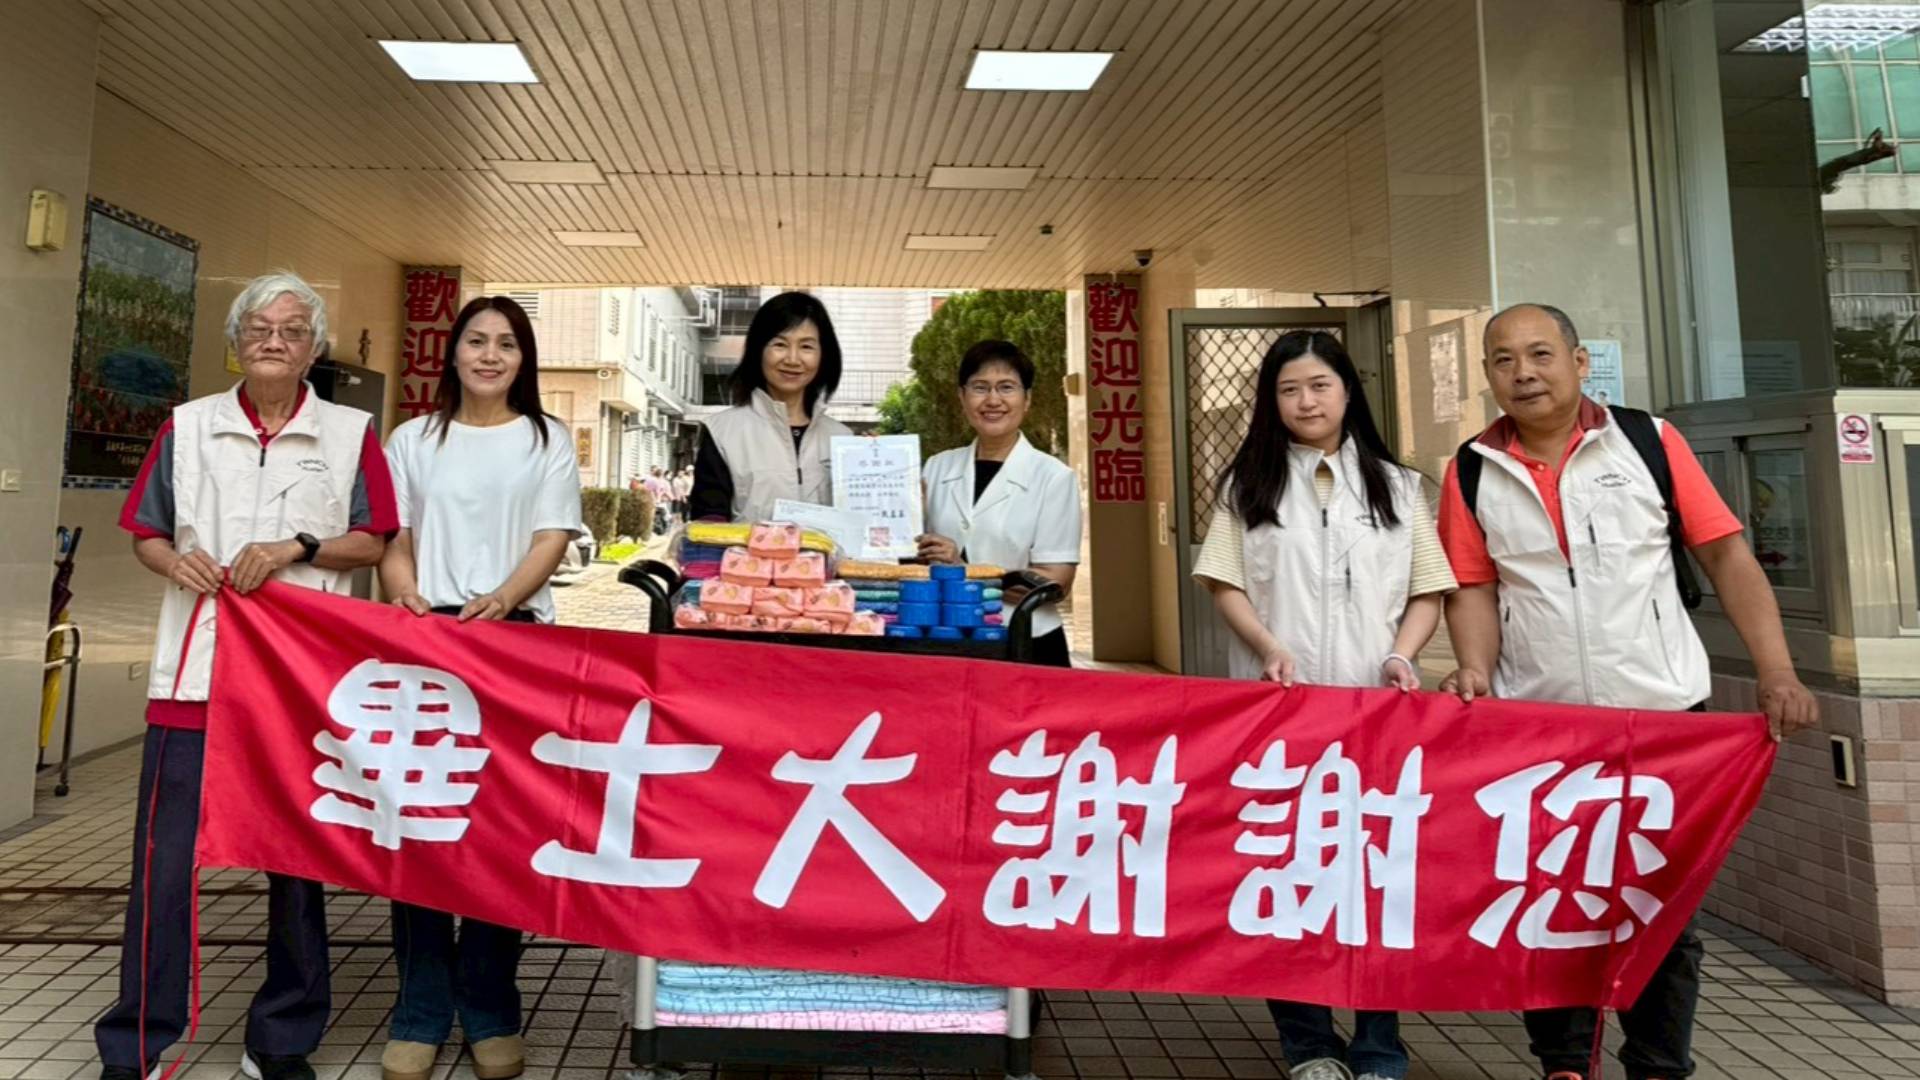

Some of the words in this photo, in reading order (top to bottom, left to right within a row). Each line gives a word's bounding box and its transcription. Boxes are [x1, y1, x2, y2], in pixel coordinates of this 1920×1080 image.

[1088, 280, 1146, 502] 歡迎光臨
[310, 659, 1675, 951] 畢士大謝謝您
